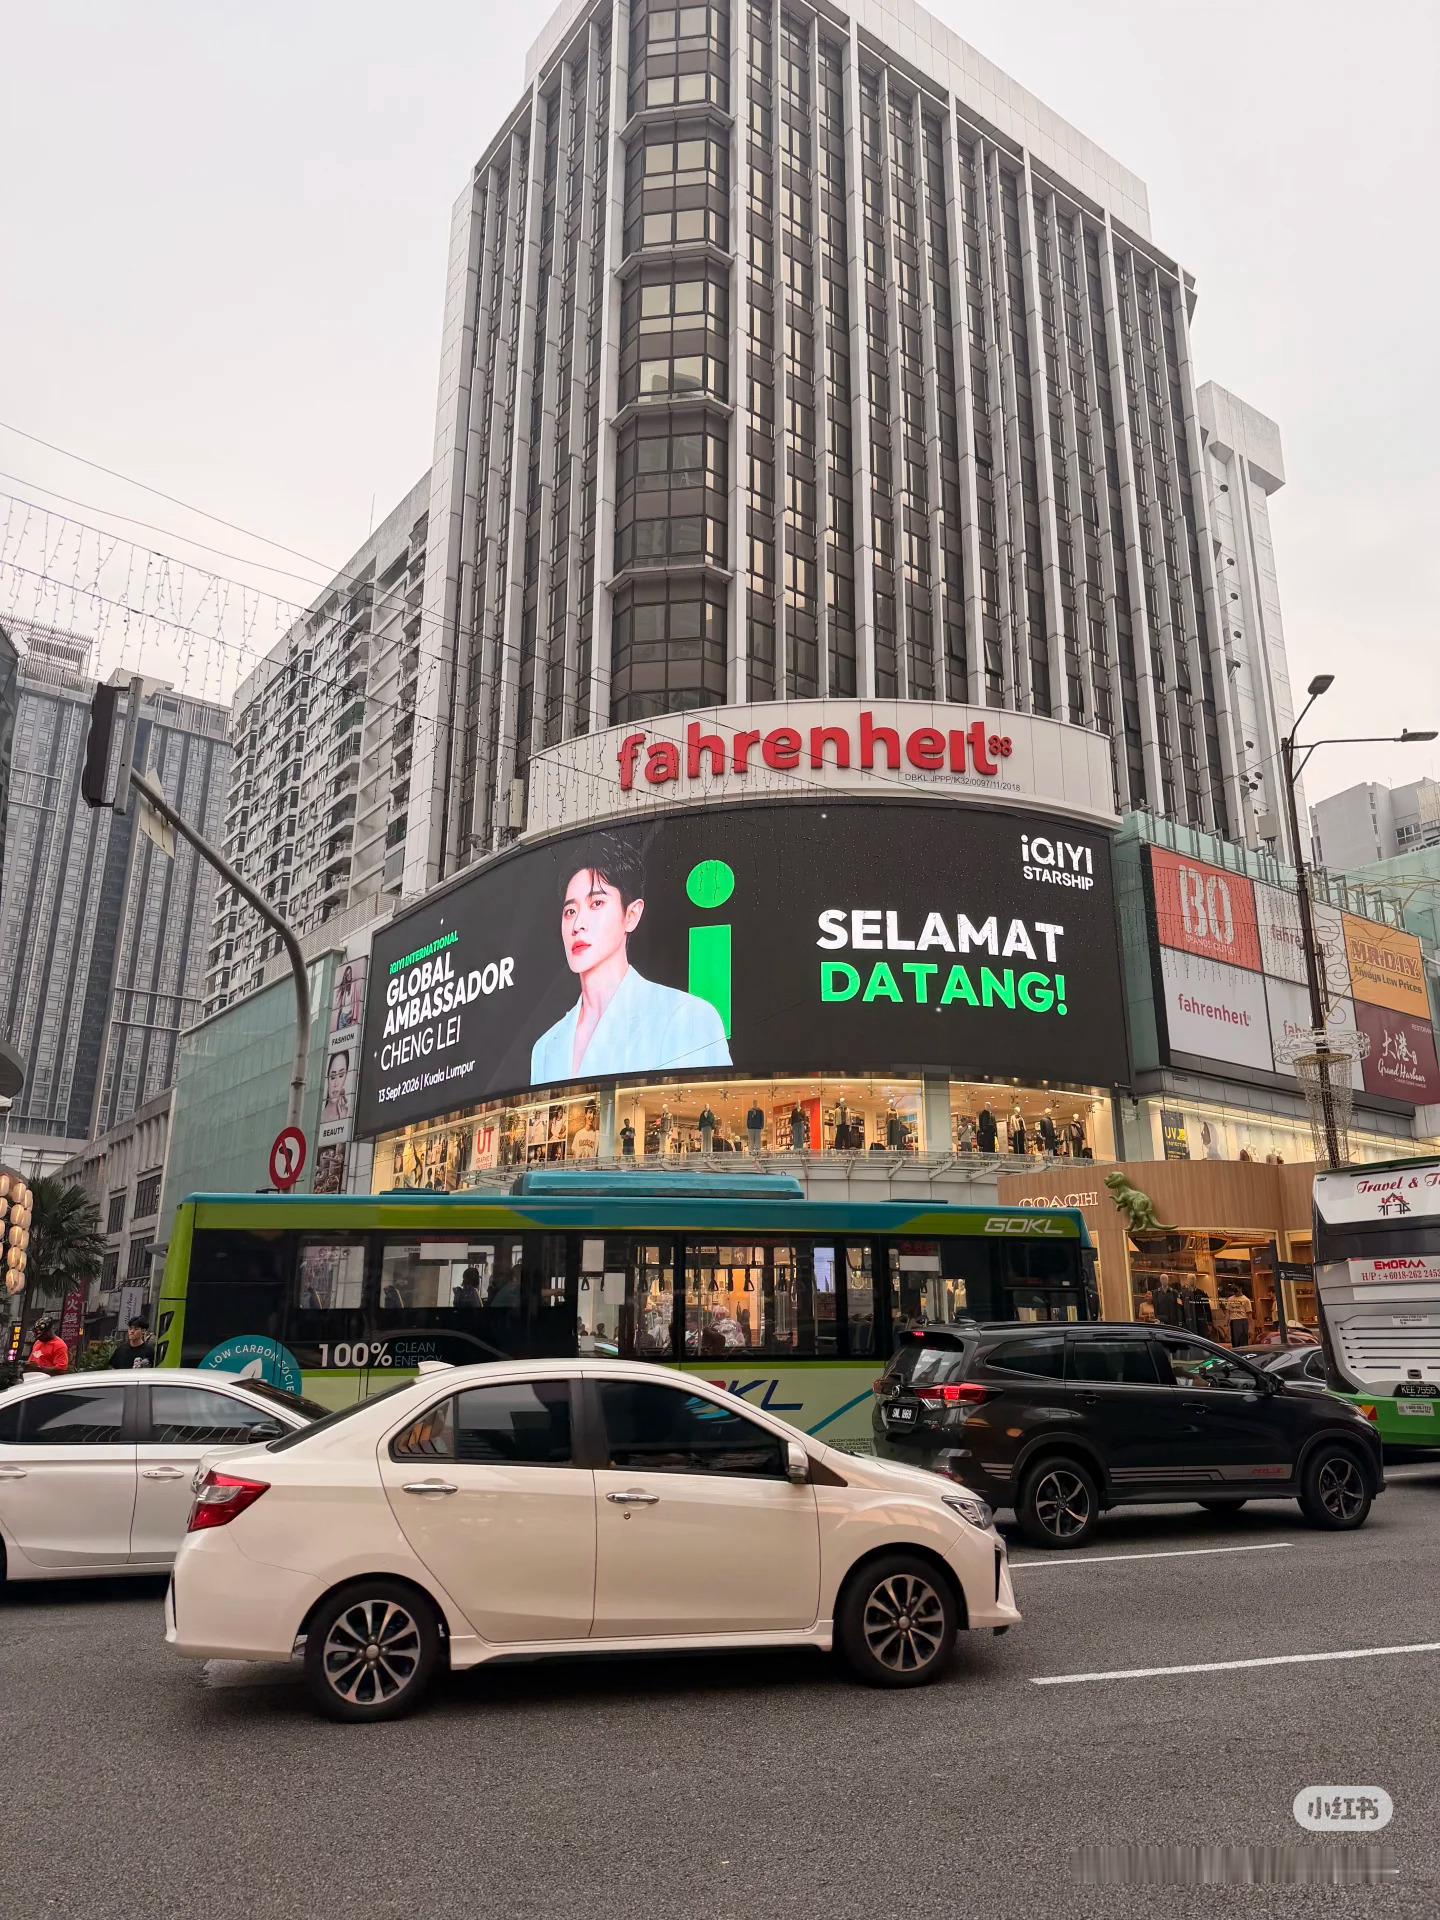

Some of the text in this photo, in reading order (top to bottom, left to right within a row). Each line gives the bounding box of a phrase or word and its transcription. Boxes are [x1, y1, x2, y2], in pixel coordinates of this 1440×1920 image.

[905, 773, 928, 782] DBKL
[1020, 834, 1094, 874] iQIYI
[1022, 865, 1094, 891] STARSHIP
[404, 930, 459, 968] INTERNATIONAL
[816, 909, 1064, 963] SELAMAT
[386, 951, 455, 1007] GLOBAL
[820, 961, 1068, 1016] DATANG!
[1382, 973, 1397, 988] Low
[1398, 979, 1423, 994] Prices
[382, 956, 515, 1039] AMBASSADOR
[331, 1032, 355, 1046] FASHION
[380, 1015, 461, 1071] CHENG LEI
[378, 1087, 386, 1103] 13
[385, 1083, 401, 1101] Sept
[401, 1077, 420, 1096] 2026
[423, 1067, 445, 1088] Kuala
[445, 1060, 476, 1079] Lumpur
[323, 1126, 345, 1138] BEAUTY
[1356, 1176, 1404, 1194] Travel
[1408, 1176, 1419, 1189] &
[1018, 1191, 1099, 1208] COACH
[984, 1217, 1063, 1235] GOKL
[1361, 1271, 1377, 1281] H/P
[319, 1342, 393, 1368] 100%
[395, 1342, 436, 1353] CLEAN
[208, 1344, 295, 1392] LOW CARBON SOCIE
[1401, 1385, 1415, 1394] KEE
